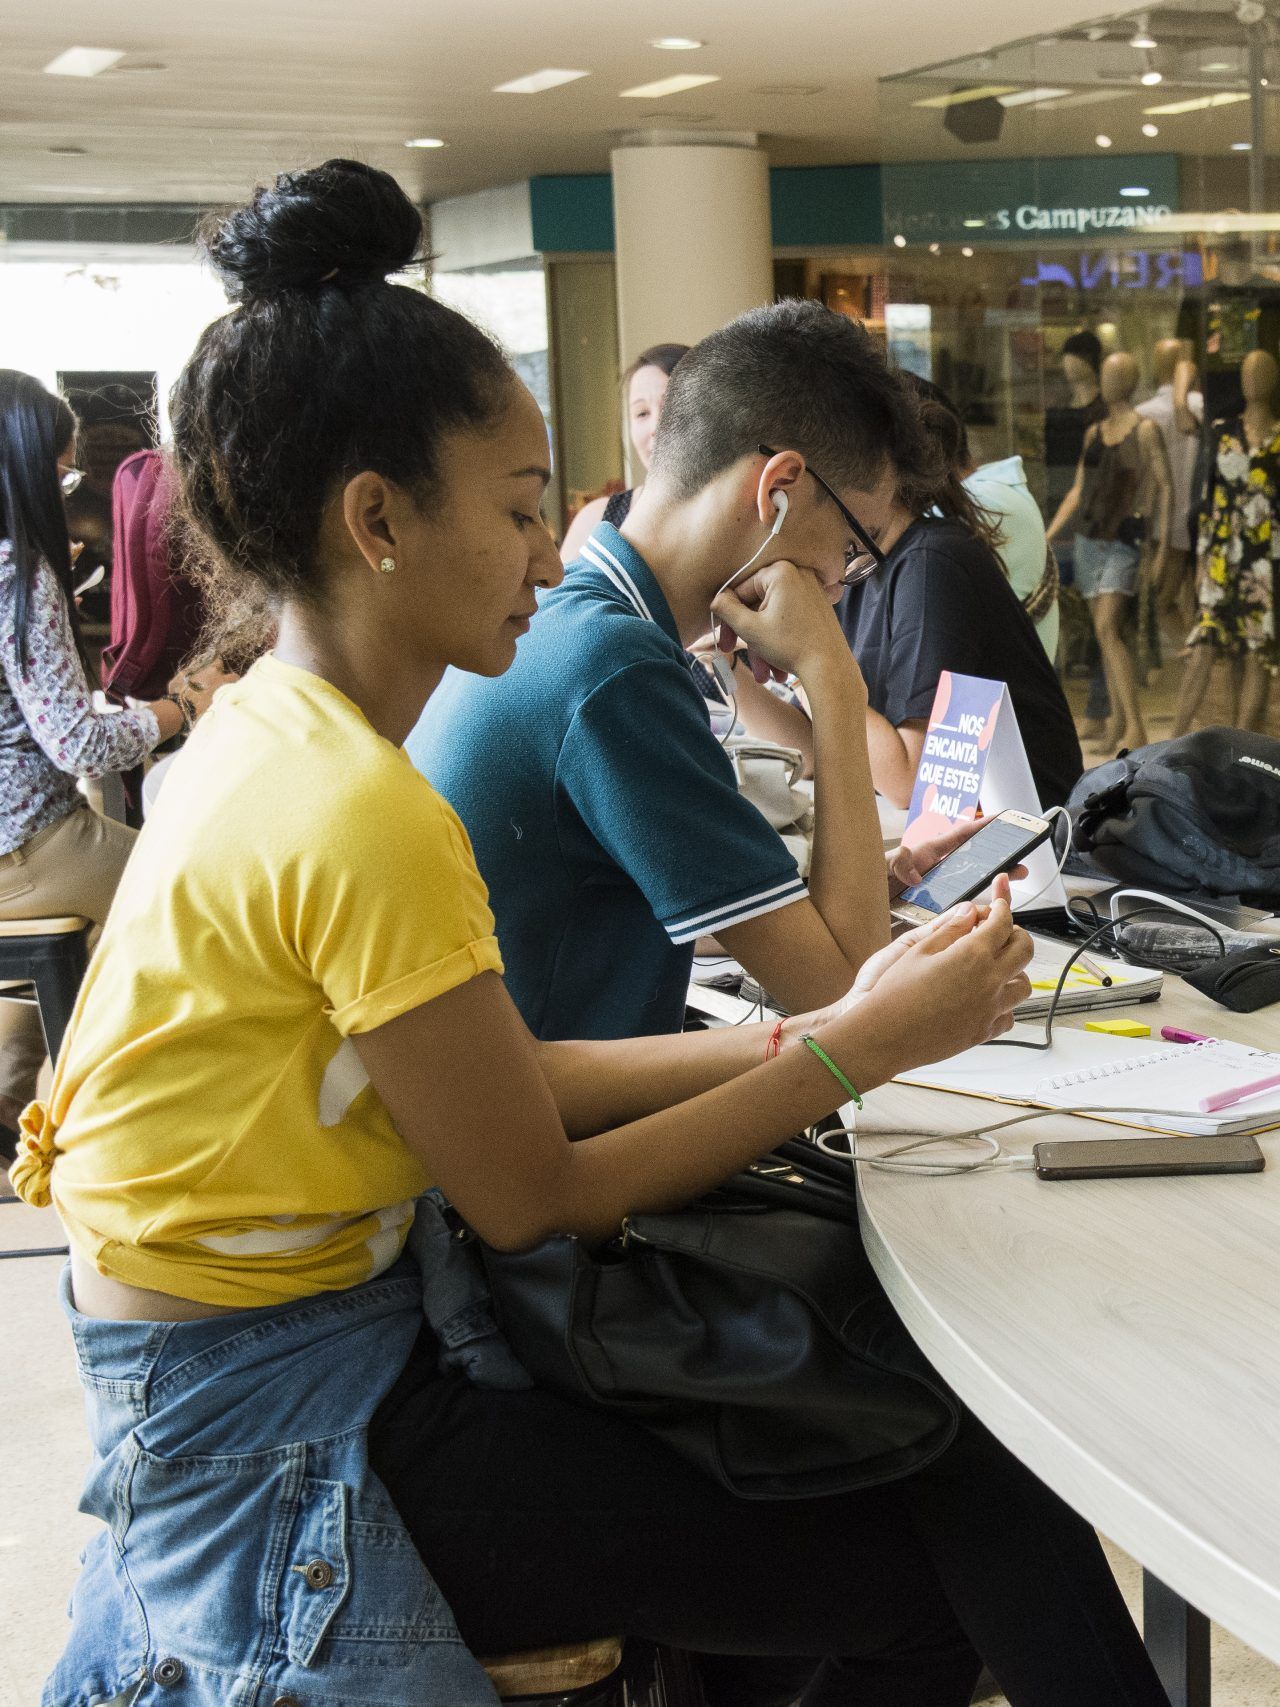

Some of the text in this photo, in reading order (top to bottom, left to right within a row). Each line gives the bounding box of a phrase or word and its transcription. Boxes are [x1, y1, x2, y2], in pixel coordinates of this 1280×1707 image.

[957, 712, 985, 737] NOS
[924, 735, 978, 765] ENCANTA
[919, 762, 980, 794] QUE ESTÉS
[928, 792, 962, 818] AQUÍ
